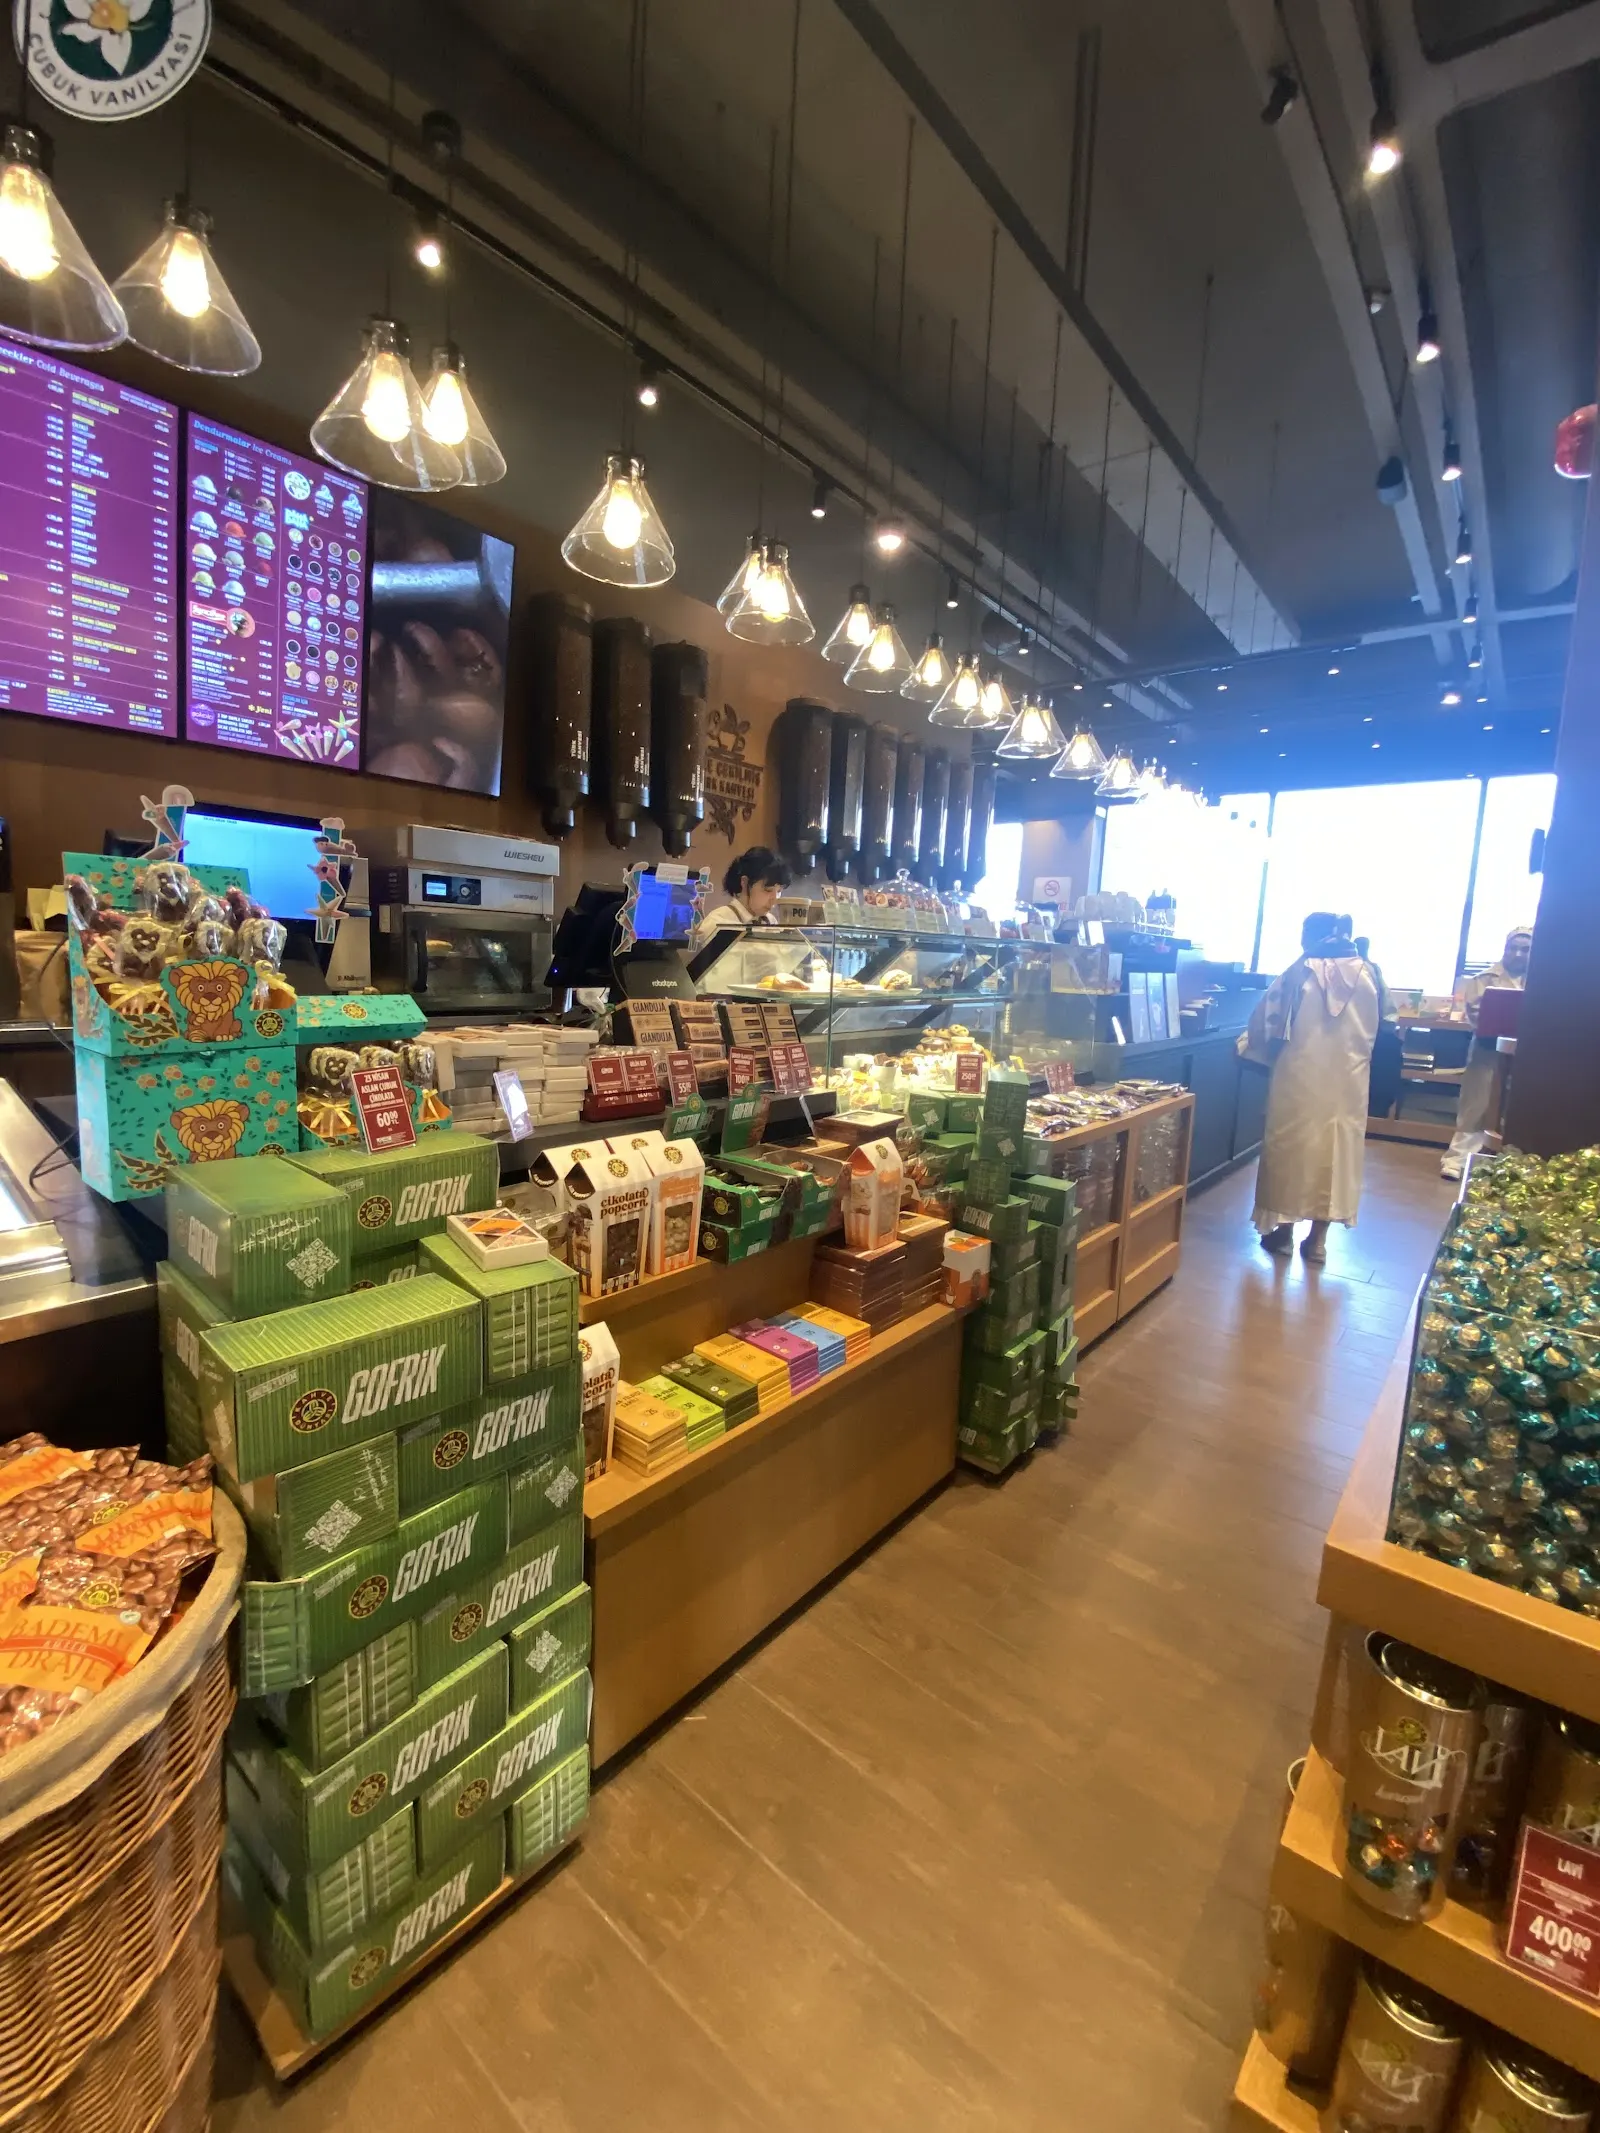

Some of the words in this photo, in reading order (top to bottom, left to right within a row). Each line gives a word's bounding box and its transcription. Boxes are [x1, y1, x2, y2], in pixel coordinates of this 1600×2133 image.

[91, 33, 193, 106] VANİLYASI
[503, 850, 545, 863] WIESHEU
[632, 1001, 667, 1013] GIANDUJA
[640, 1031, 674, 1043] GIANDUJA
[361, 1083, 379, 1094] ASLAN
[368, 1091, 396, 1104] ÇİKOLATA
[600, 1198, 649, 1220] popcorn
[7, 1650, 101, 1682] DRAJE
